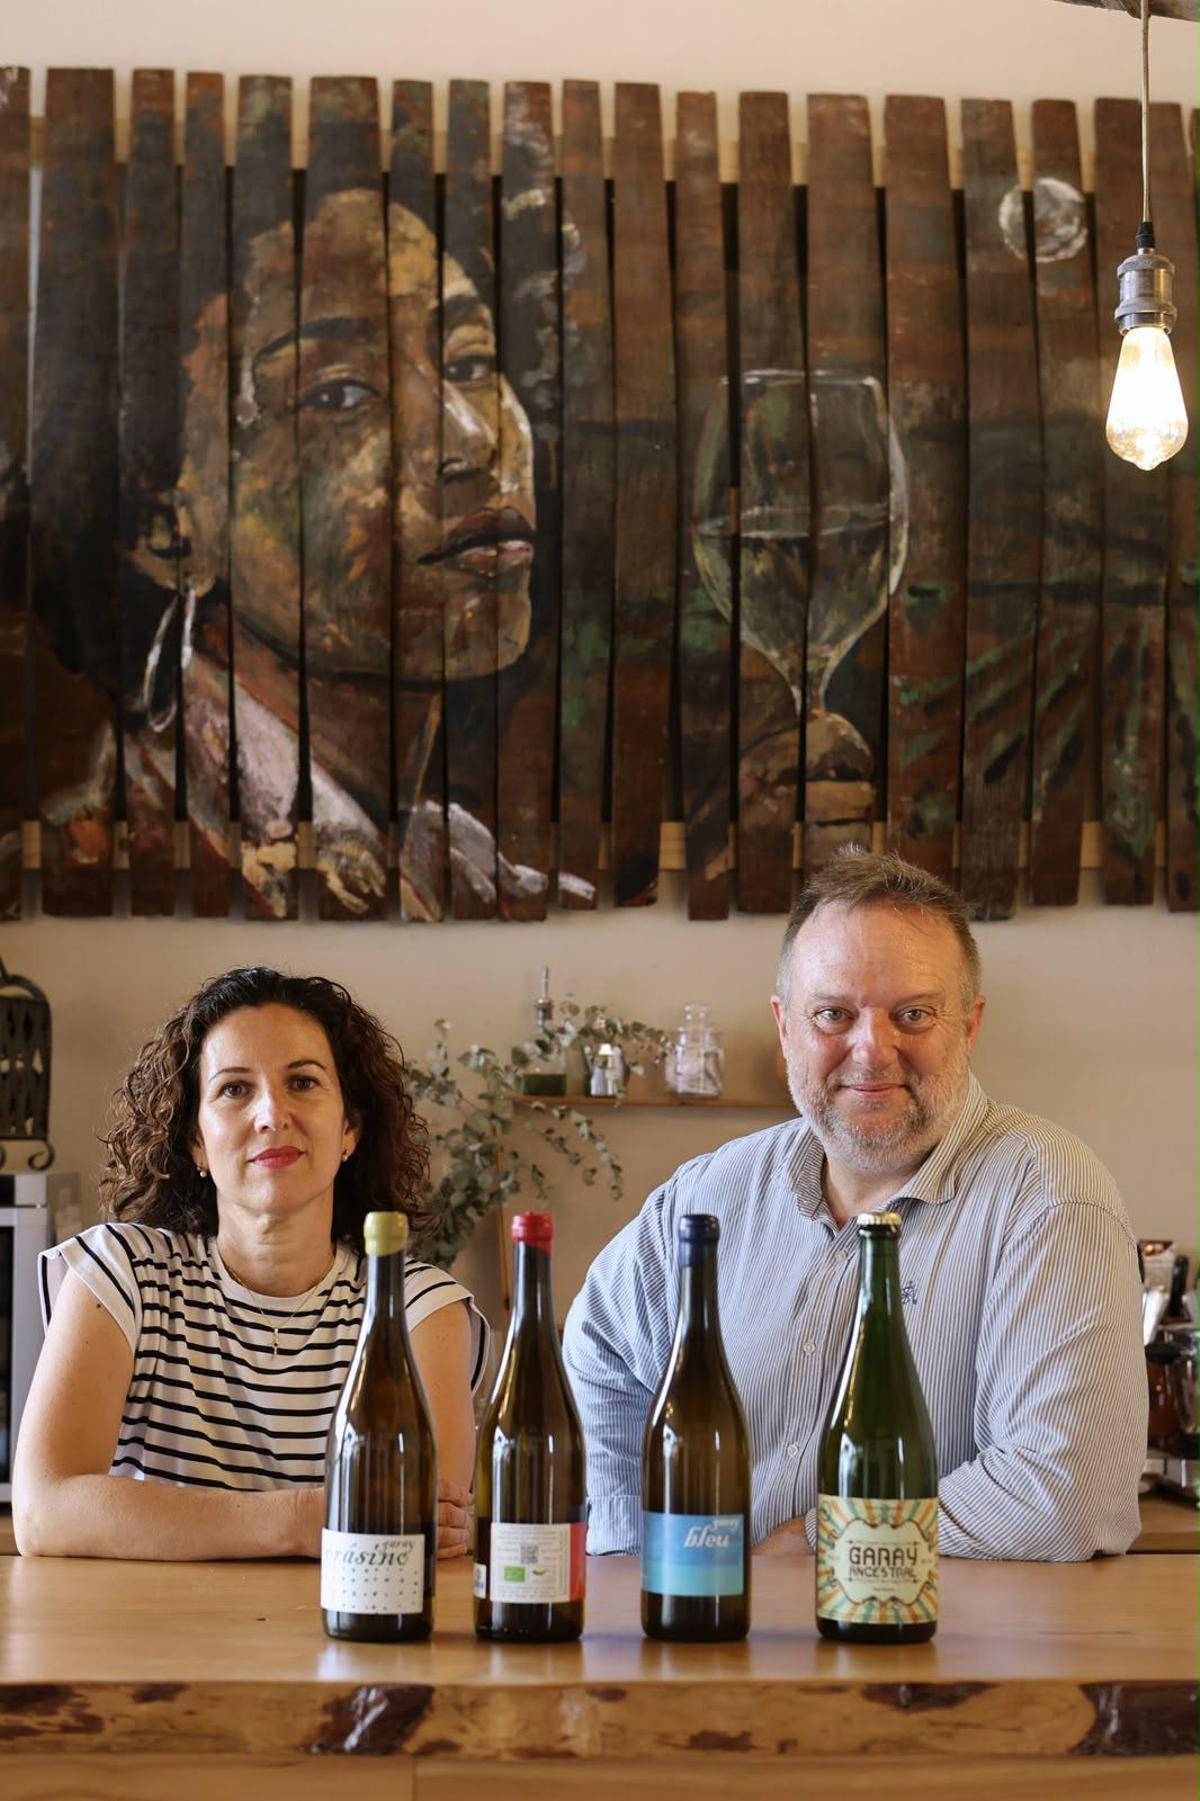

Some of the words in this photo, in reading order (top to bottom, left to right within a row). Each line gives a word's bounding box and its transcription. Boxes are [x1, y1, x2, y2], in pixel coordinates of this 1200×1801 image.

[683, 1524, 729, 1548] bleu
[849, 1546, 918, 1566] GARAY
[849, 1565, 917, 1579] ANCESTRAL
